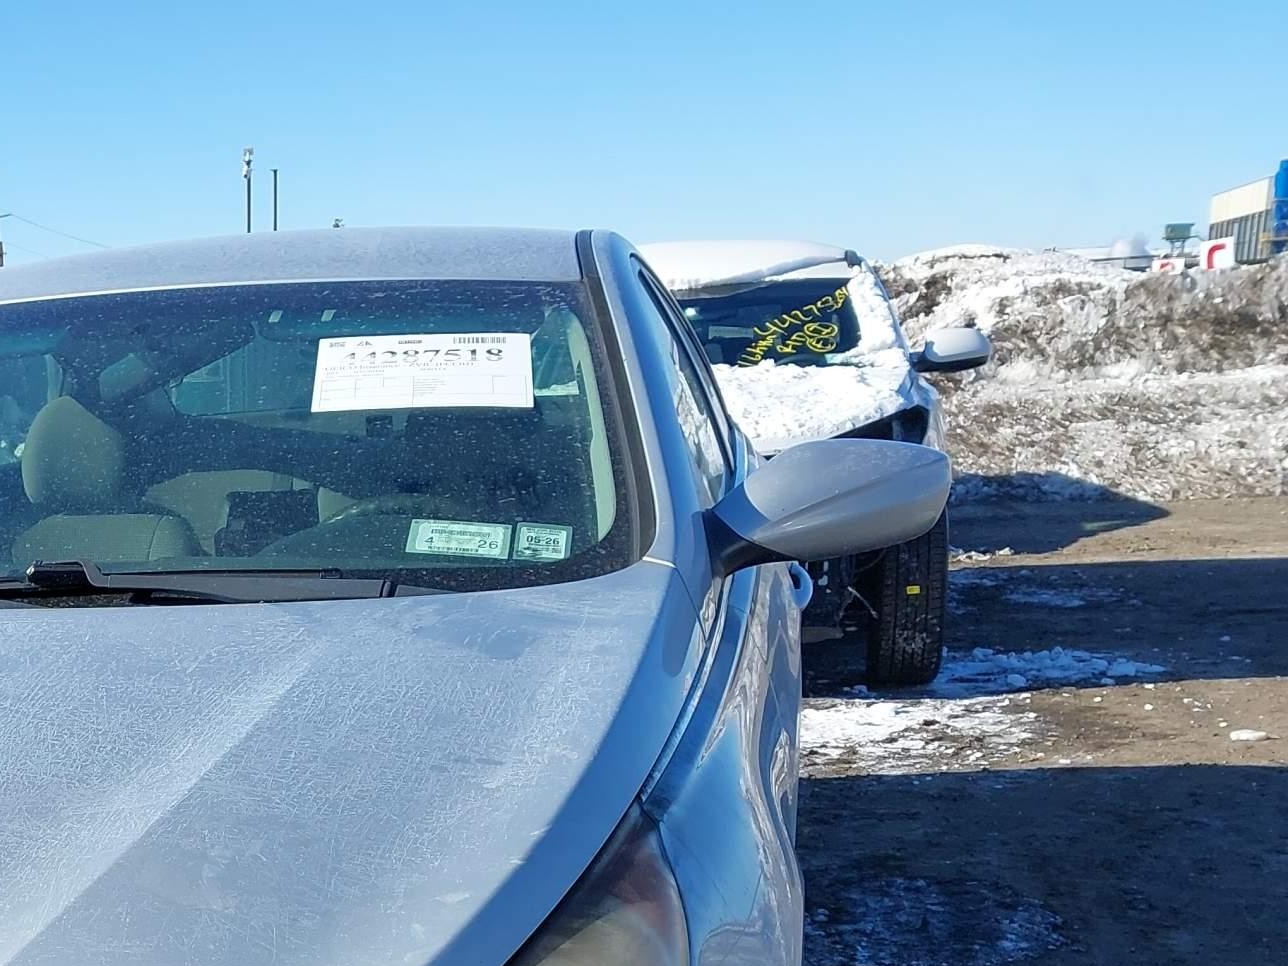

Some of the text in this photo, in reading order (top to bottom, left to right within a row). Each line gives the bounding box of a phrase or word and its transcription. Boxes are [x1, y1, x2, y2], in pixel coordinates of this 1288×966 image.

[342, 348, 504, 365] 44287518
[478, 539, 499, 550] 26
[526, 535, 560, 545] 05-26
